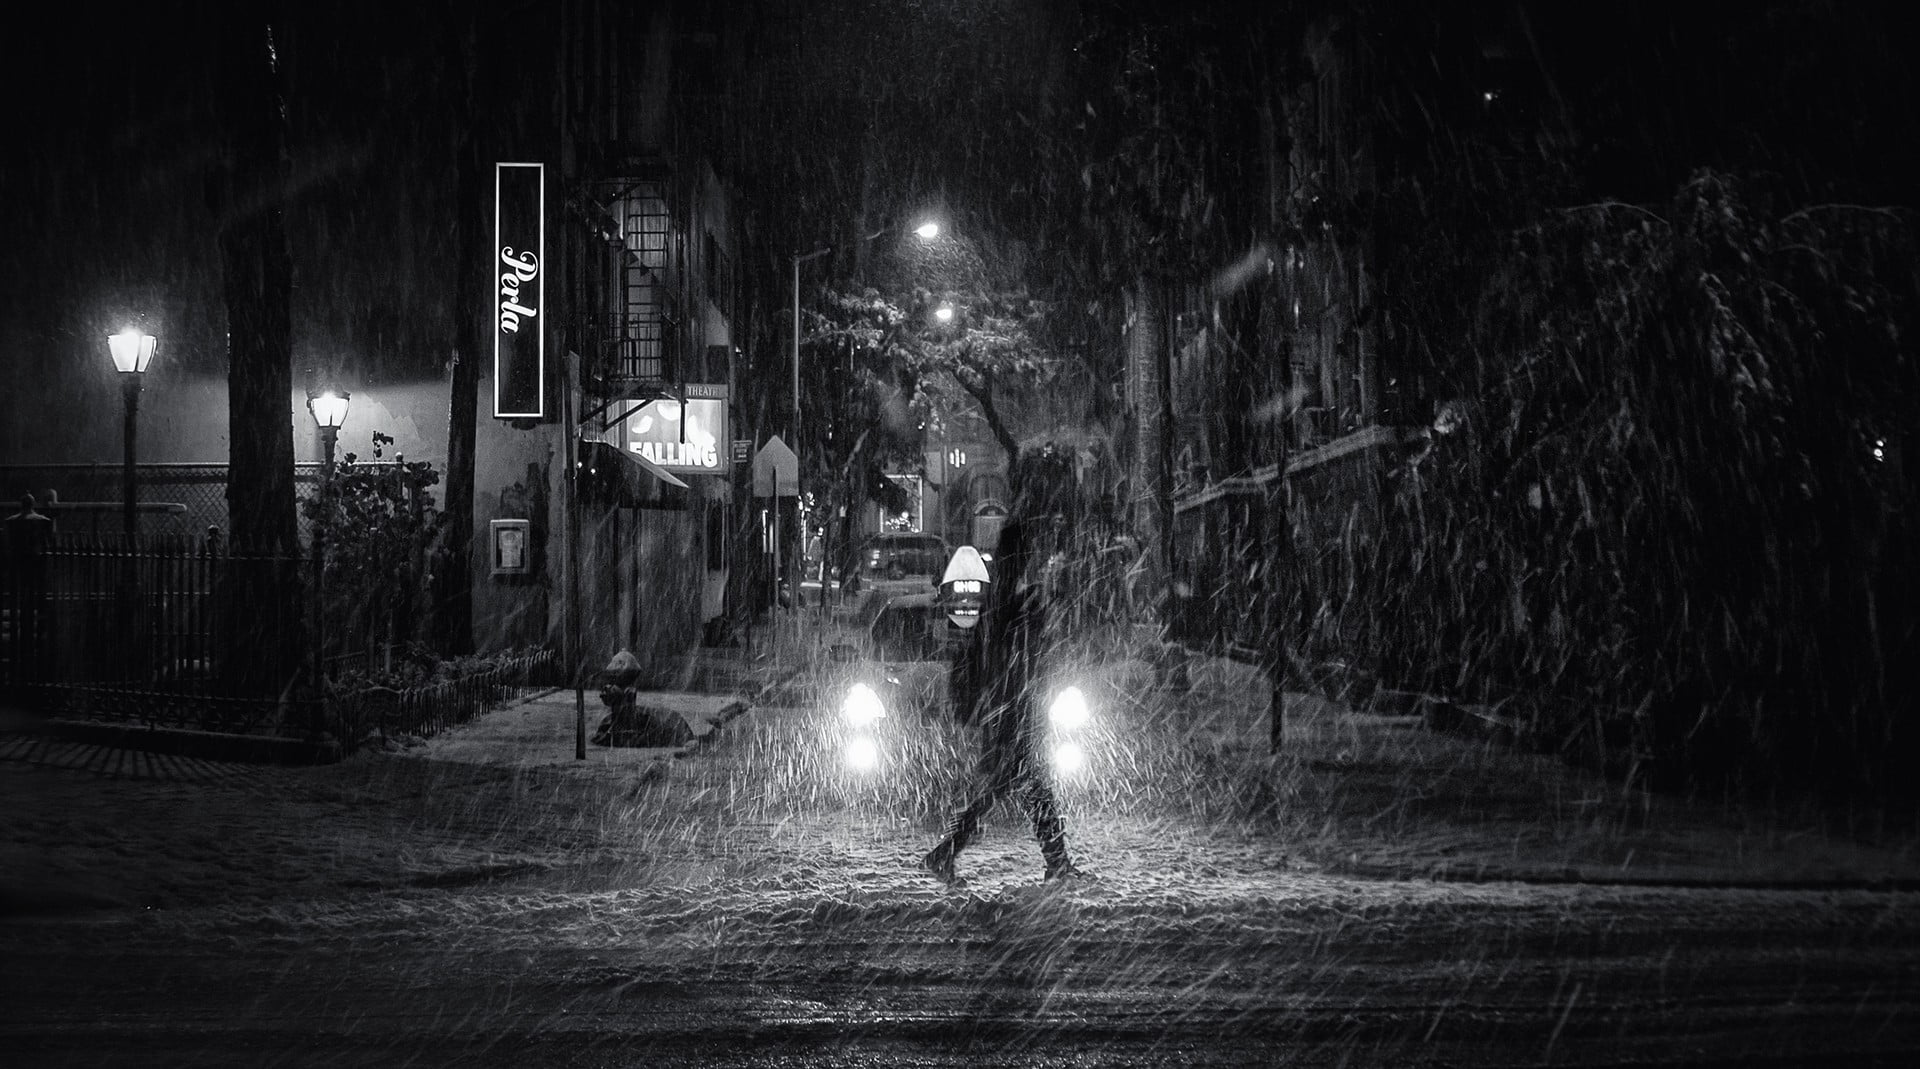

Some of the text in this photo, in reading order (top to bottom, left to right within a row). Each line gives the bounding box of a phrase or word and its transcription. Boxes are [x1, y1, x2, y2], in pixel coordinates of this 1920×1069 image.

[501, 246, 538, 334] Perla
[687, 384, 722, 397] THEATR
[629, 441, 718, 468] FALLING
